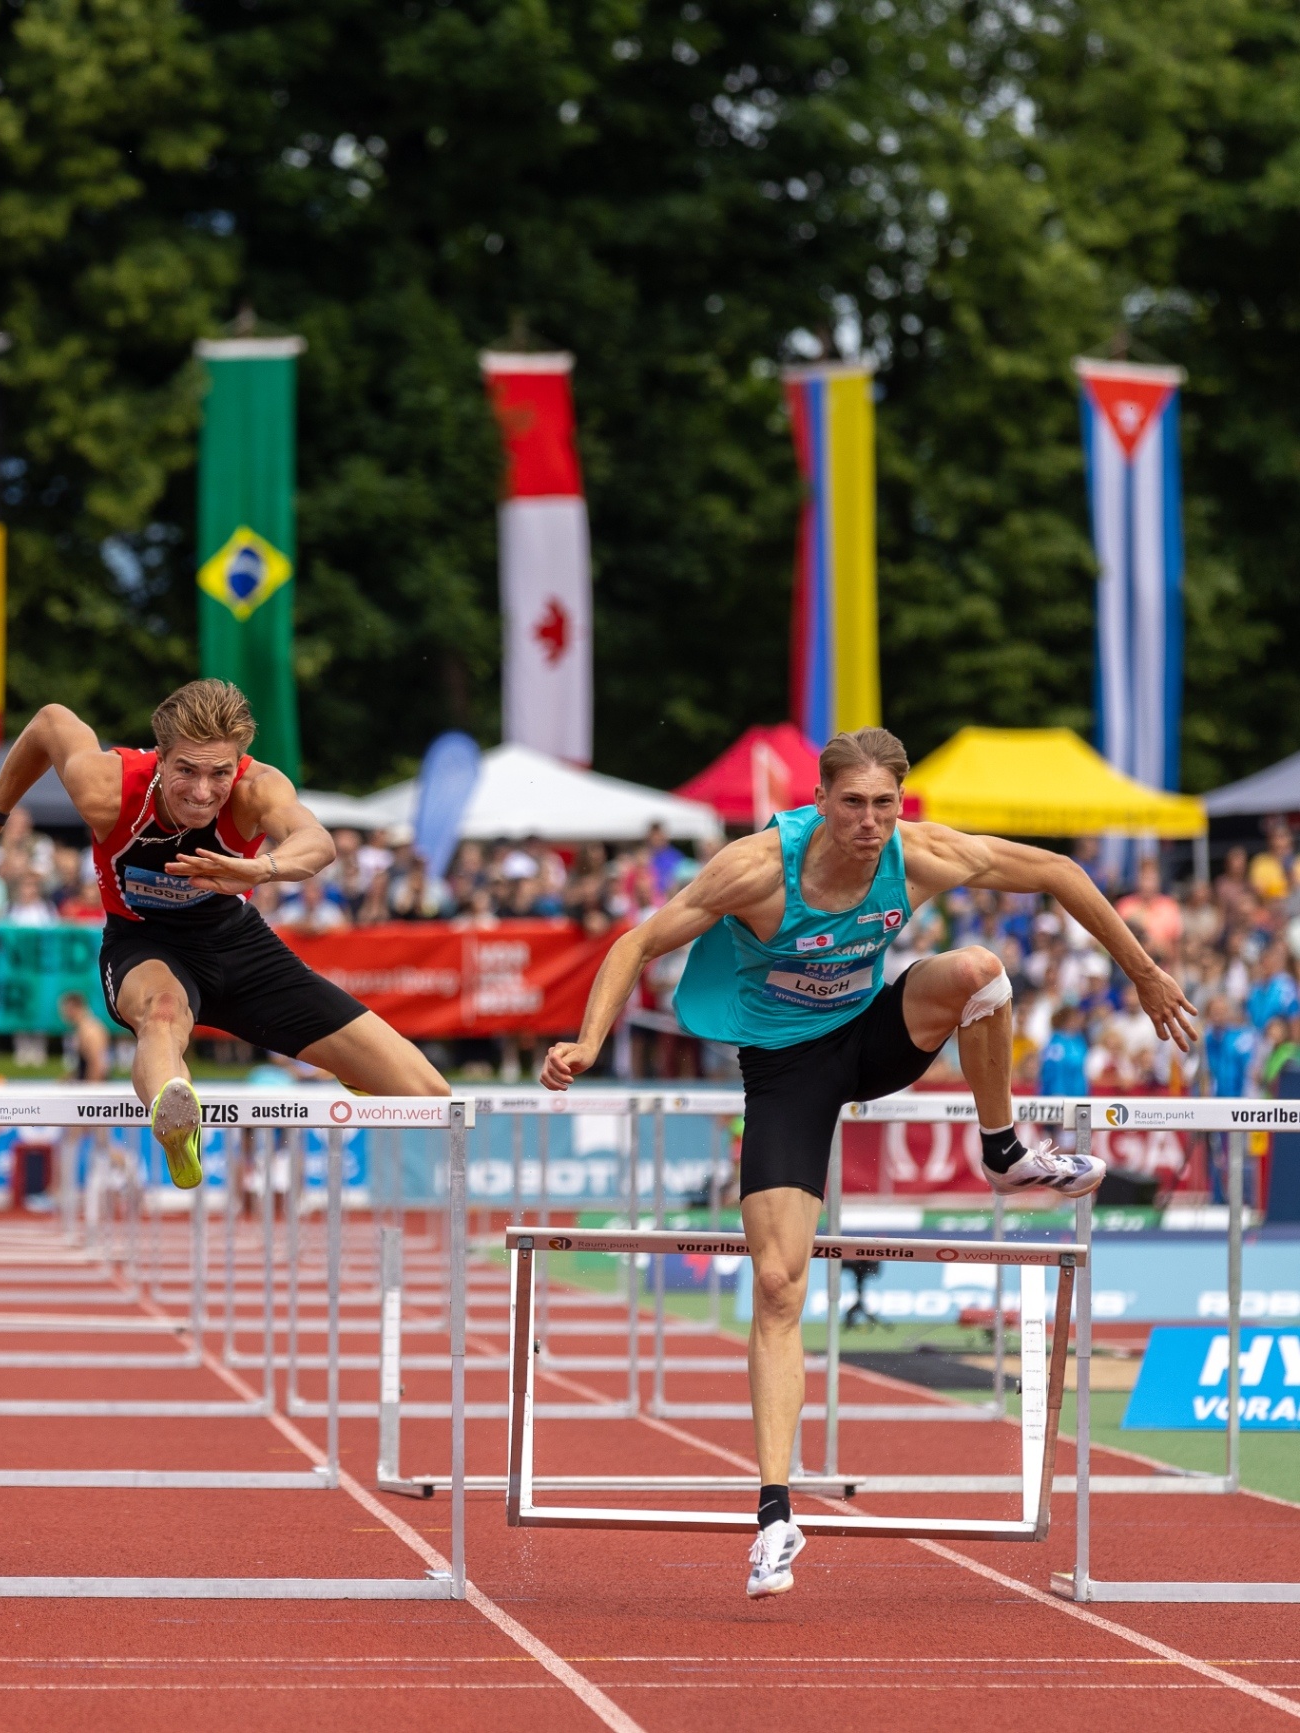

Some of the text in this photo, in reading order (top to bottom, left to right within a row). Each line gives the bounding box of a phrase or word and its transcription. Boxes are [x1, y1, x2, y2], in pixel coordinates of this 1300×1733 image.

[155, 876, 190, 887] HYP
[131, 884, 210, 901] TESSELA
[795, 979, 850, 996] LASCH
[200, 1104, 239, 1123] TZIS
[252, 1103, 309, 1118] austria
[357, 1105, 443, 1120] wohn.wert
[1134, 1110, 1195, 1121] Raum.punkt
[1231, 1108, 1300, 1123] vorarlbe
[578, 1241, 639, 1249] Raum.punkt
[856, 1247, 914, 1258] austria
[964, 1252, 1052, 1263] wohn.wert
